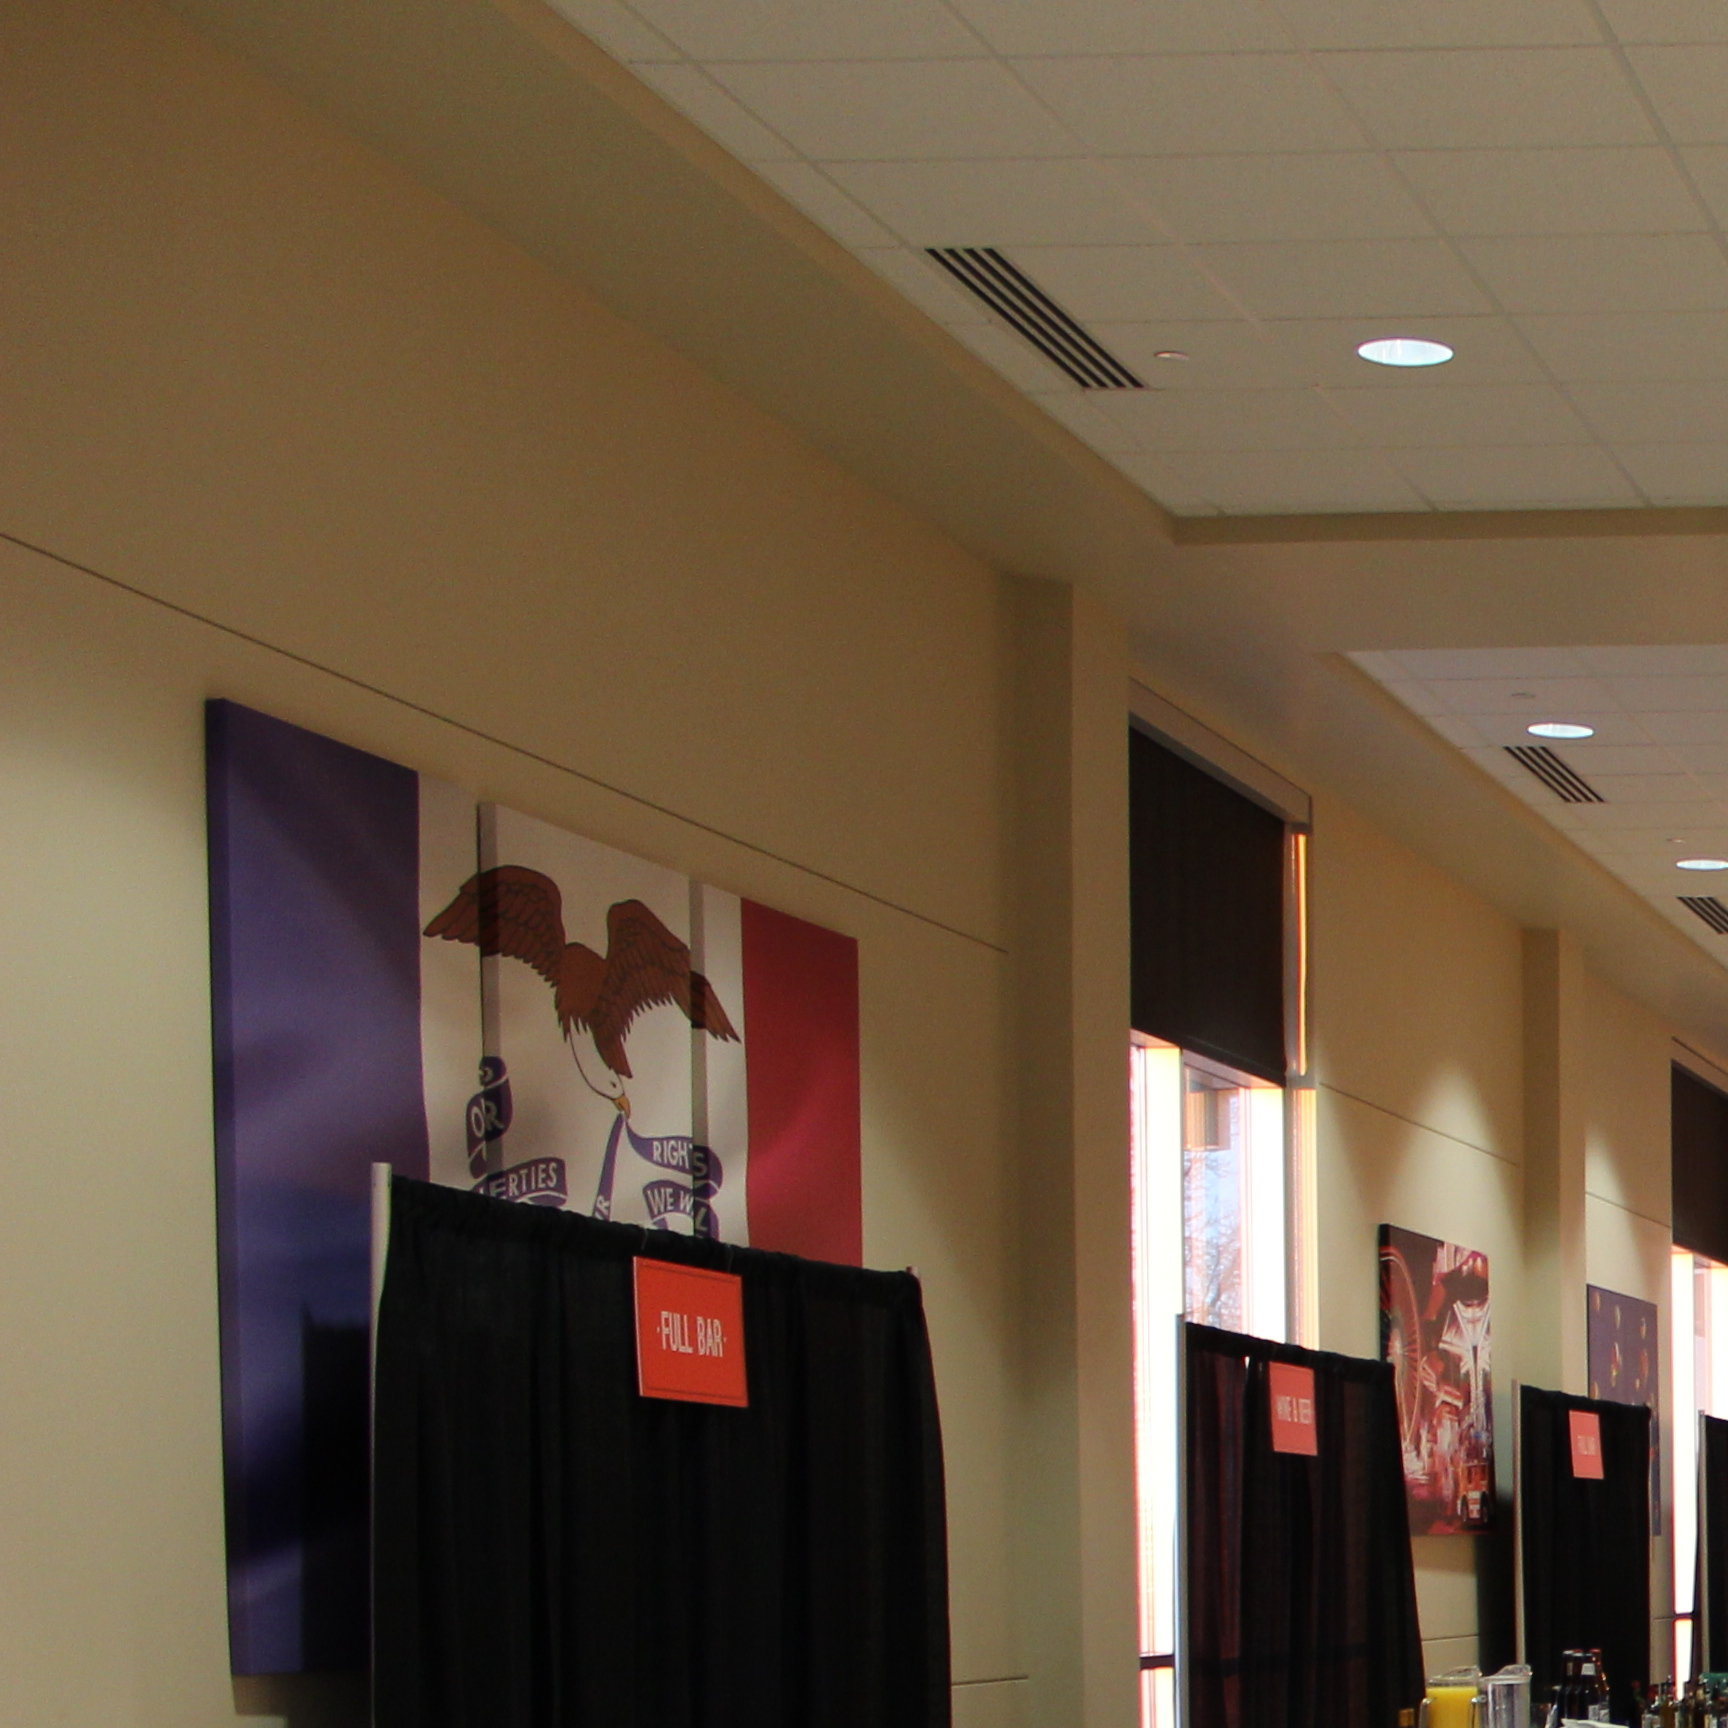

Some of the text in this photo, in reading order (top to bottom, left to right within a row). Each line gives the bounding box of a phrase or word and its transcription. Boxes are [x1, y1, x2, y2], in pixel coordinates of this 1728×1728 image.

[653, 1140, 708, 1177] RIGHS
[647, 1188, 674, 1216] WE
[660, 1311, 723, 1358] FULL BAR
